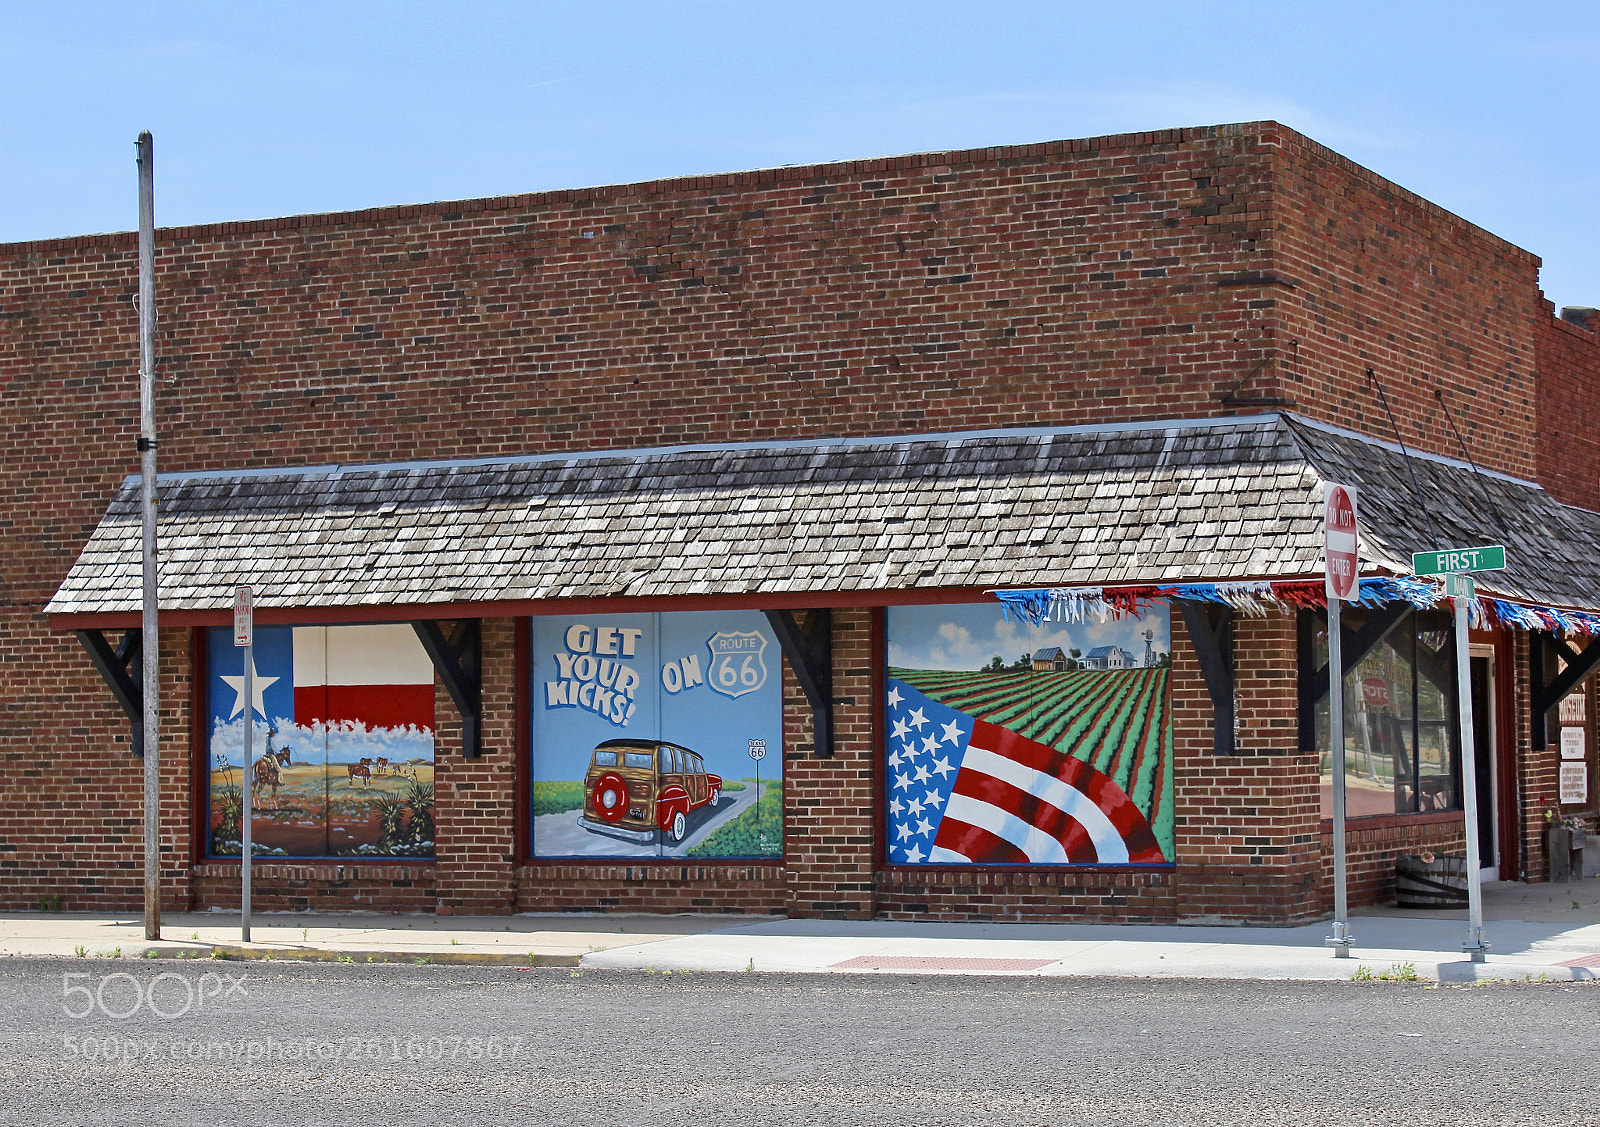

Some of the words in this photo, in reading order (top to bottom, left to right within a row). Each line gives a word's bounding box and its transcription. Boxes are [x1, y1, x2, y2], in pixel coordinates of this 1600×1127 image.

[1328, 507, 1337, 524] DO
[1340, 509, 1352, 527] NOT
[1332, 557, 1351, 577] ENTER
[1436, 551, 1480, 571] FIRST
[565, 624, 642, 657] GET
[719, 637, 757, 649] ROUTE
[555, 653, 640, 700] YOUR
[662, 655, 702, 694] ON
[718, 655, 758, 686] 66
[545, 680, 637, 727] KICKS!
[751, 747, 764, 757] 66
